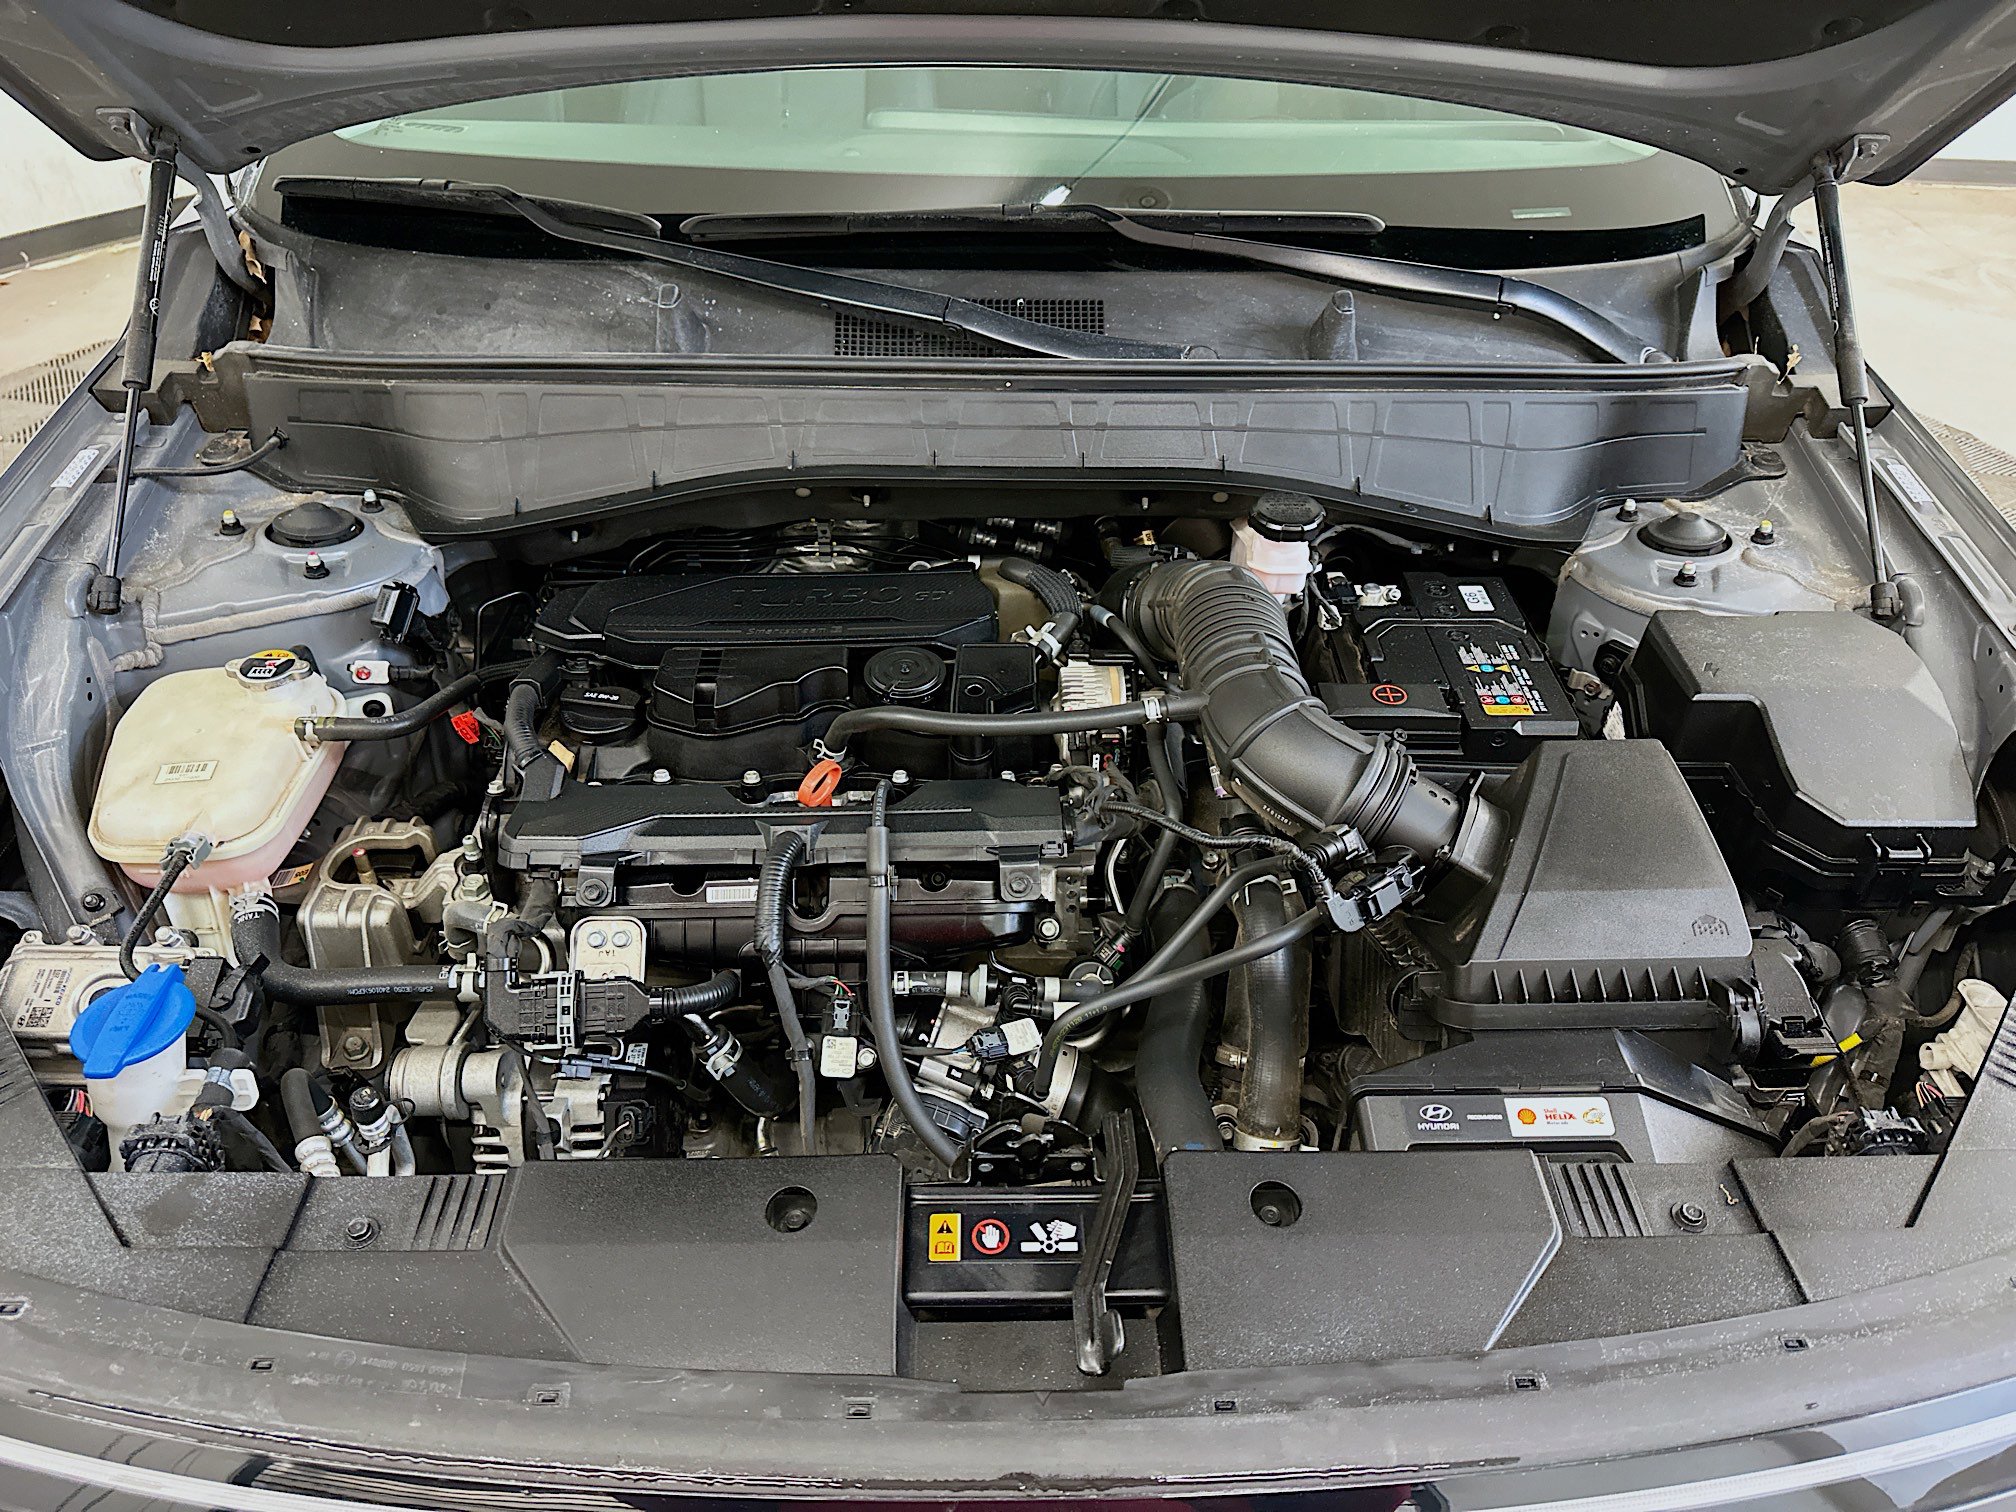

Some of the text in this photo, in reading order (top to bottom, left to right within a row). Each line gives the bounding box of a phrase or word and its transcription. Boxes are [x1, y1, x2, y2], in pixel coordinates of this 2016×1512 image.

[731, 586, 902, 608] TURBO
[1464, 591, 1481, 604] G6
[237, 909, 262, 924] TANK
[1544, 1112, 1577, 1121] HELIX
[1417, 1122, 1460, 1131] HYUNDAI
